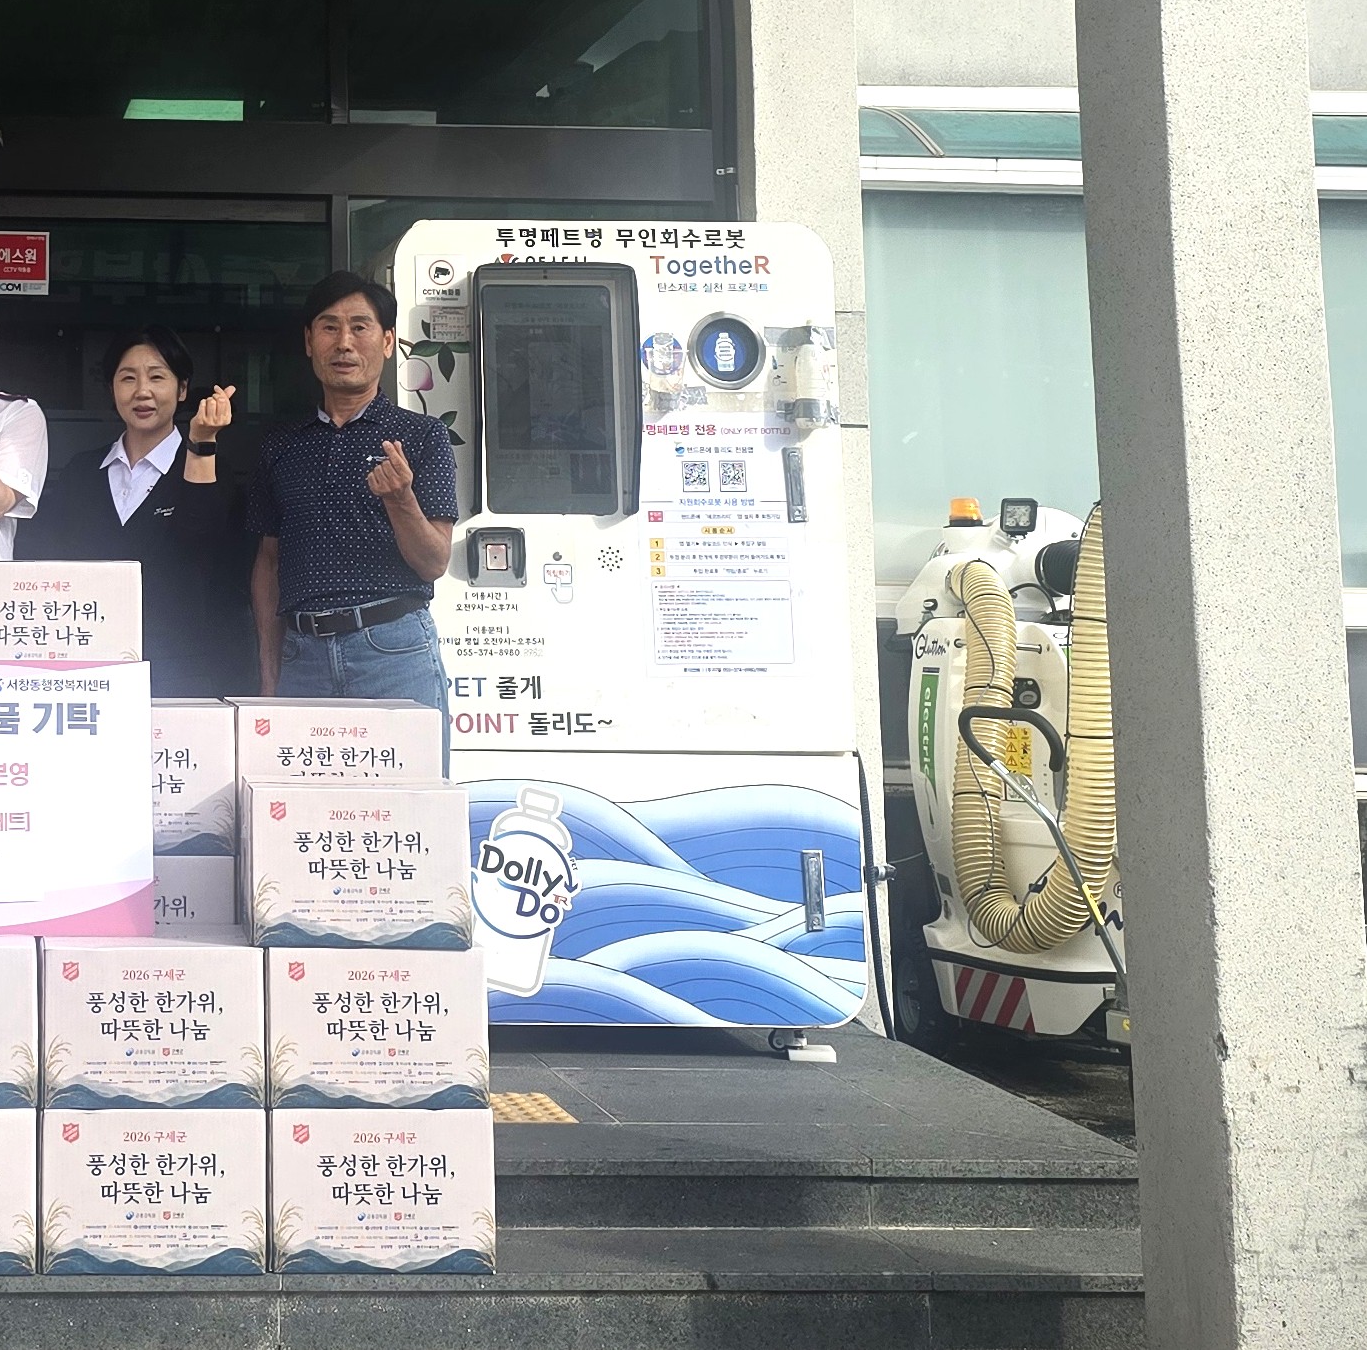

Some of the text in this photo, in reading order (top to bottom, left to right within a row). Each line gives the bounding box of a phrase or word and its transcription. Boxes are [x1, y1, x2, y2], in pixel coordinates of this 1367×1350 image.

[495, 227, 746, 249] 투명페트병 무인회수로봇
[649, 255, 771, 277] TogetheR
[422, 288, 441, 296] CCTV
[657, 282, 769, 293] 탄소제로 실천 프로젝트
[642, 424, 690, 435] 명페트병
[694, 424, 717, 435] 전용
[744, 427, 758, 435] PET
[656, 567, 661, 575] 3
[12, 580, 72, 593] 2026 구세군
[42, 600, 105, 623] 한가위,
[456, 603, 518, 611] 오전9시~오후7시
[55, 625, 93, 646] 나눔
[483, 637, 545, 646] 오전9시~오후5시
[457, 648, 520, 656] 055-374-8980
[6, 678, 110, 692] 서창동행정복지센터
[496, 675, 542, 700] 줄게
[32, 702, 101, 736] 기탁
[448, 711, 613, 736] OINT 돌리도~
[309, 726, 369, 739] 2026 구세군
[922, 687, 932, 776] electric
[151, 747, 198, 771] 가위,
[276, 745, 403, 770] 풍성한 한가위,
[328, 809, 392, 822] 2026 구세군
[293, 830, 429, 856] 풍성한 한가위,
[307, 857, 417, 881] 따뜻한 나눔
[480, 843, 564, 897] Dolly
[569, 858, 578, 871] PET
[153, 895, 196, 920] 가위,
[514, 886, 560, 924] Do
[347, 969, 411, 982] 2026 구세군
[311, 990, 449, 1017] 풍성한 한가위,
[326, 1018, 437, 1042] 따뜻한 나눔
[353, 1131, 418, 1145] 2026 구세군
[316, 1153, 455, 1179] 풍성한 한가위,
[331, 1181, 443, 1206] 따뜻한 나눔
